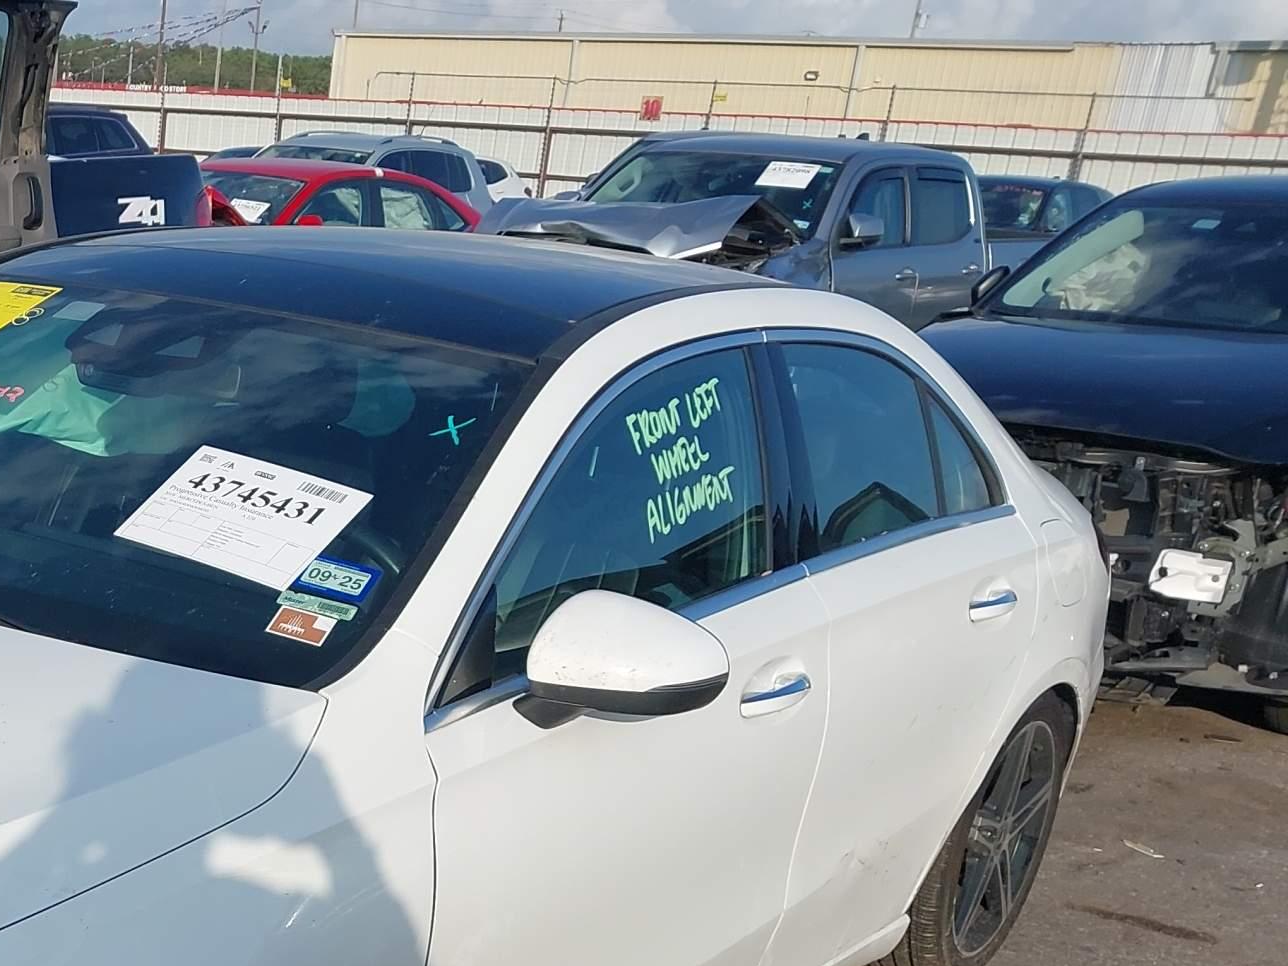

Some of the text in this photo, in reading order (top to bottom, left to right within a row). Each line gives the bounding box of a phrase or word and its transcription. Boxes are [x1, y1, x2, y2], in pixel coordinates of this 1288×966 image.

[625, 377, 721, 456] FRONT LEFT
[187, 472, 327, 526] 43745431
[308, 567, 363, 590] 09 25
